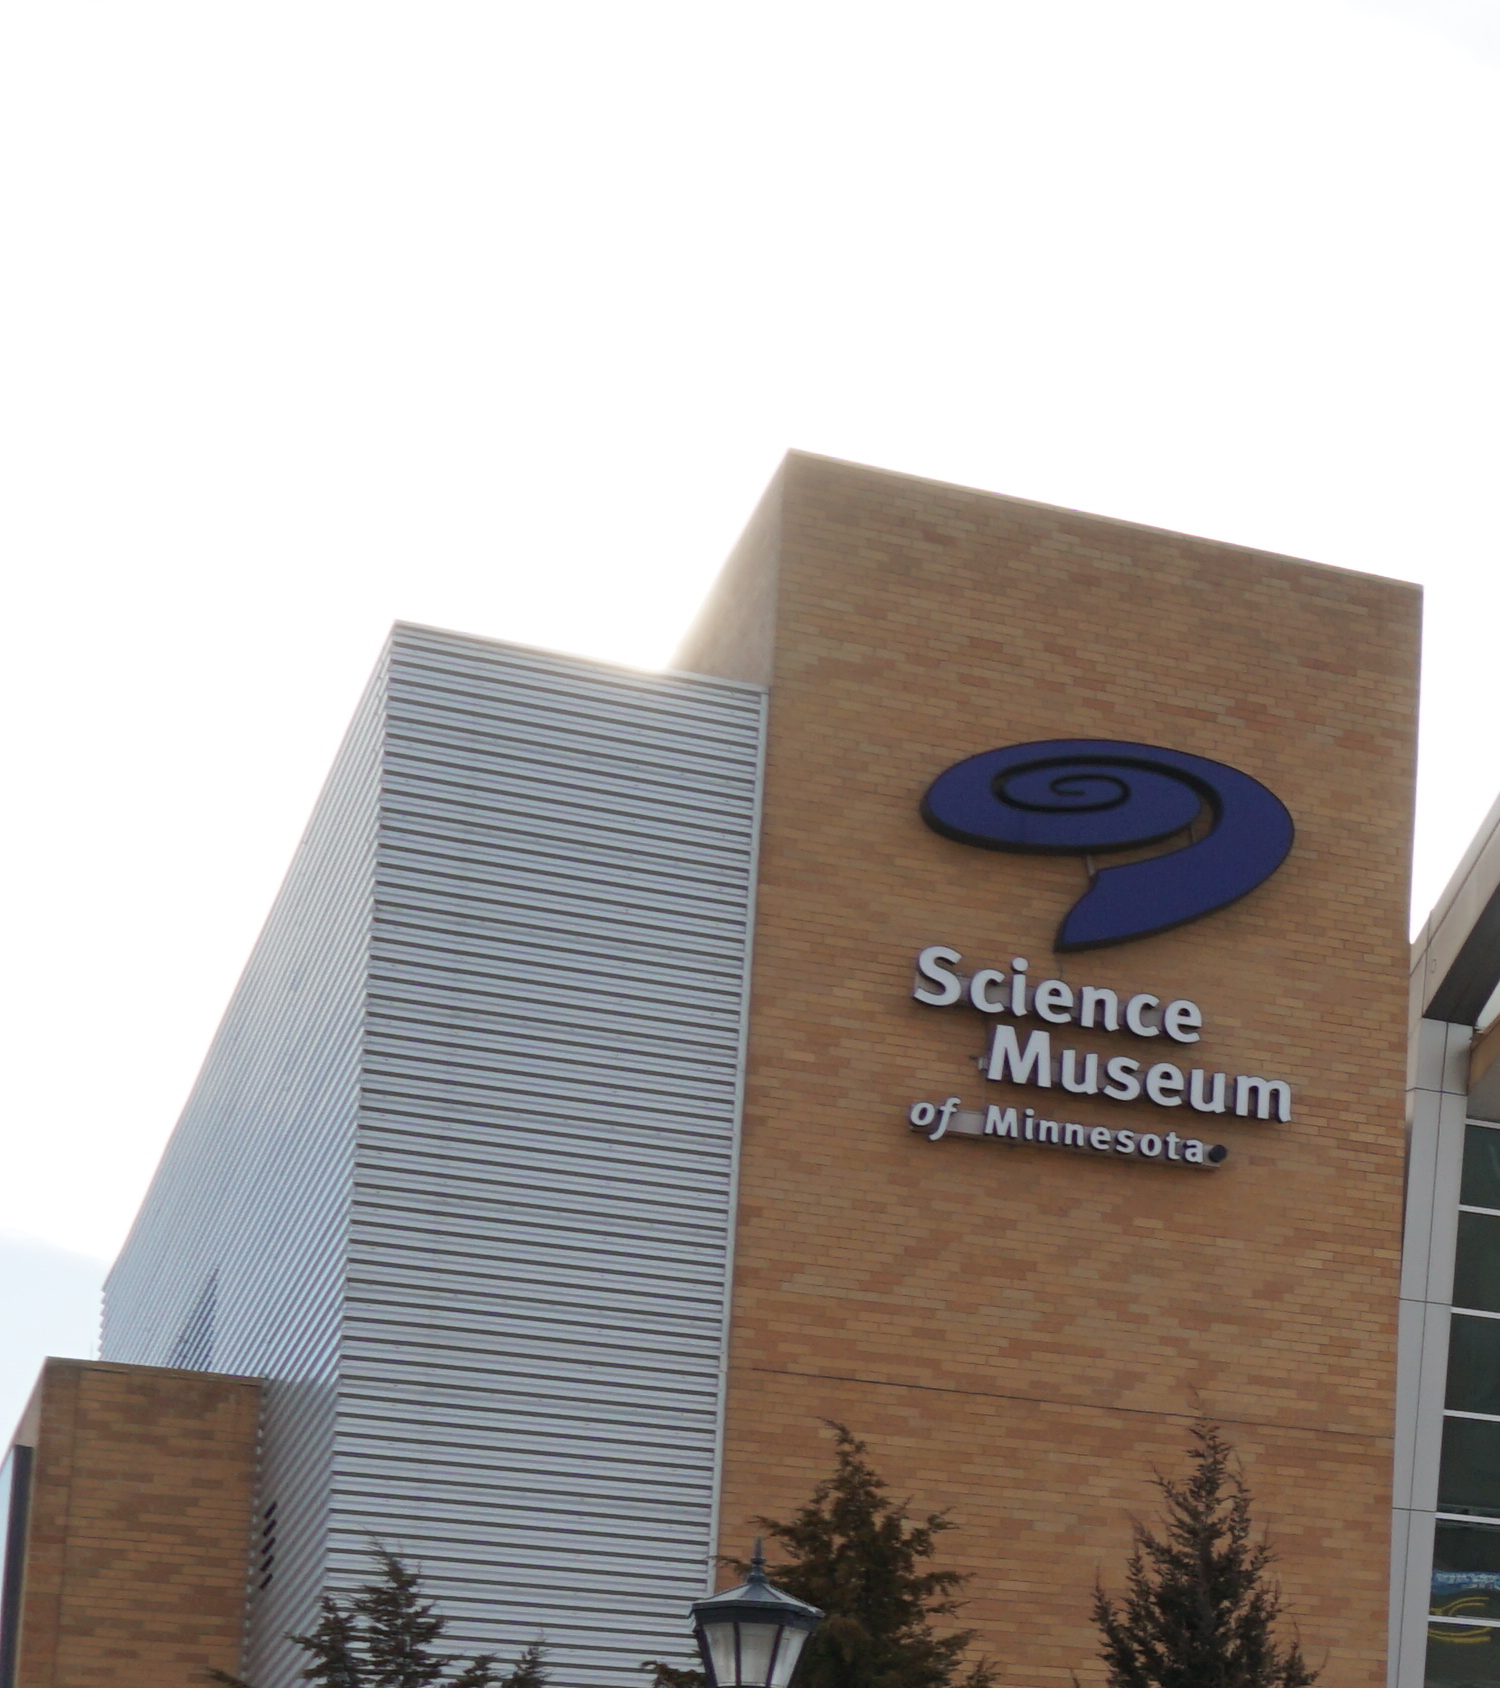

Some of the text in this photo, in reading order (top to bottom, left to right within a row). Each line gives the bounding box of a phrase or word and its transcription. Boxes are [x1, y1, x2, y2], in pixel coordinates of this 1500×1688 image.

[913, 945, 1203, 1044] Science
[985, 1025, 1292, 1124] Museum
[909, 1096, 1205, 1164] of Minnesota
